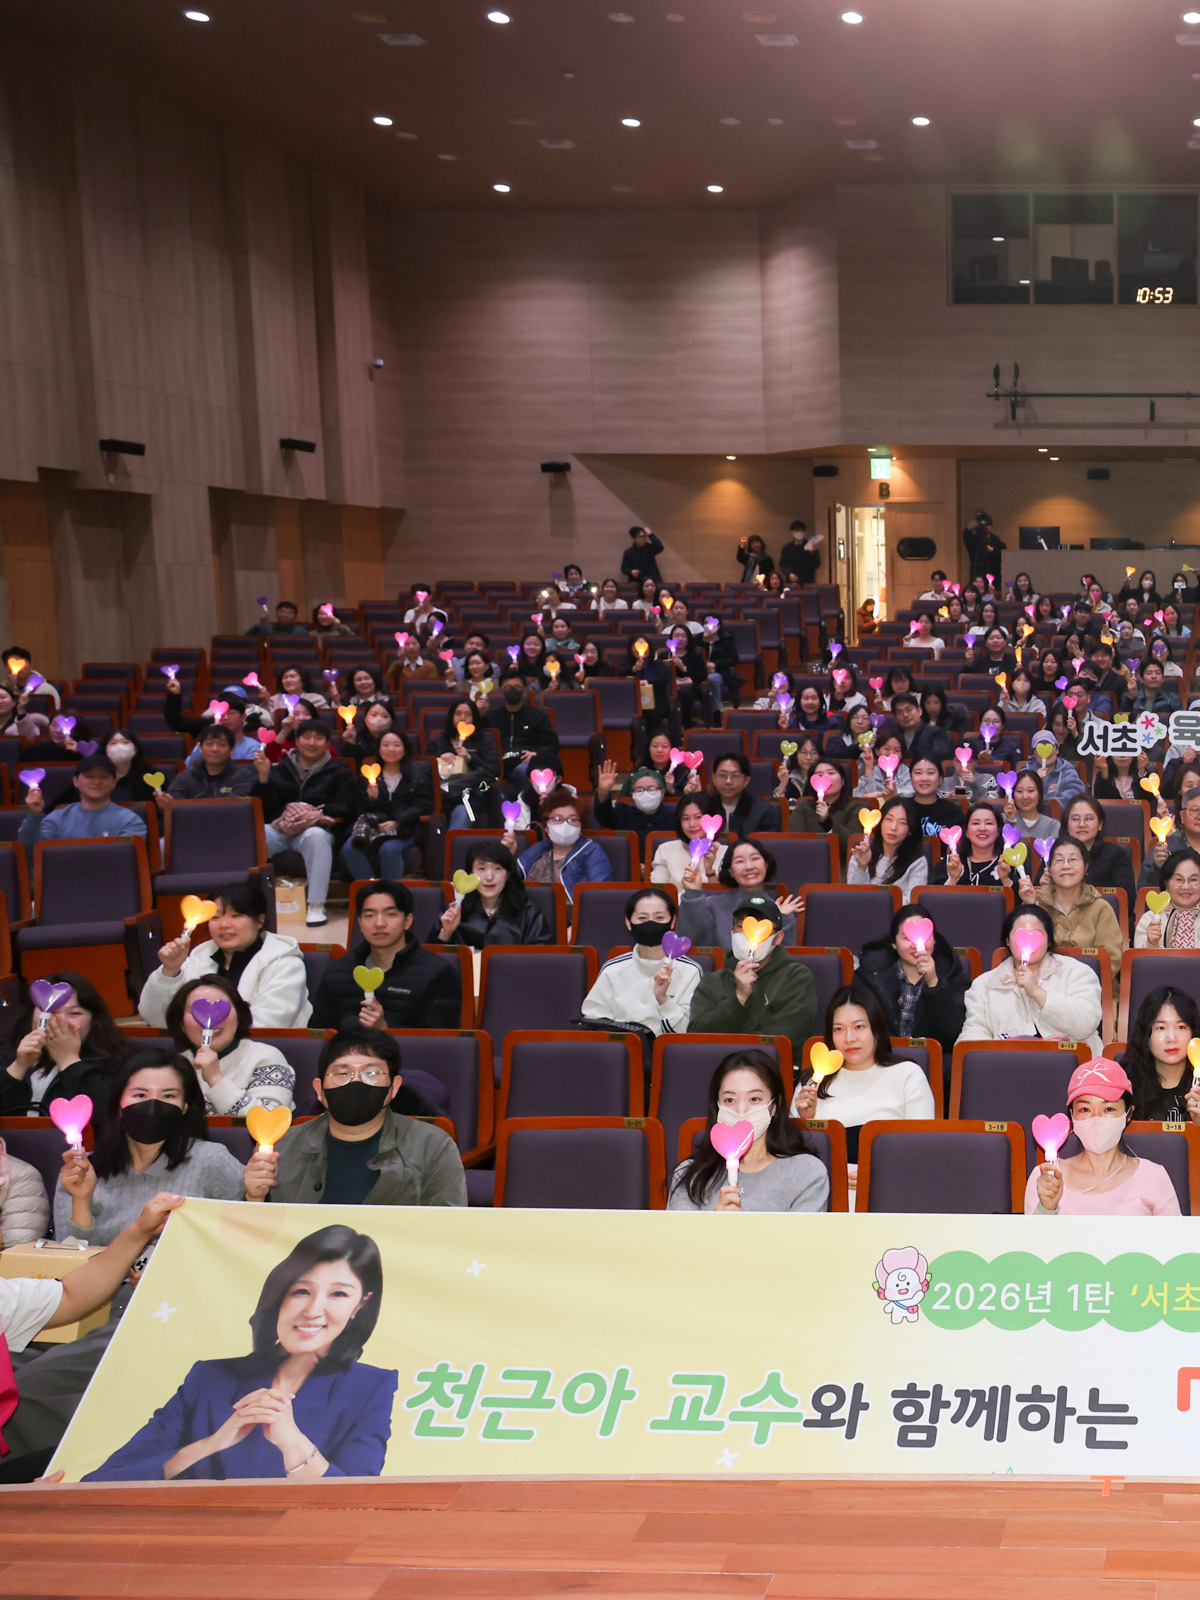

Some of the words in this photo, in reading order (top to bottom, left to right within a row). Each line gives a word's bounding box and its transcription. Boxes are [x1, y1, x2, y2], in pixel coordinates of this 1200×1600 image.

[1136, 287, 1174, 304] 10:53
[878, 482, 891, 499] B
[1081, 723, 1139, 753] 서초
[988, 1123, 1004, 1131] 3-19
[1166, 1123, 1182, 1131] 3-18
[931, 1281, 1052, 1313] 2026년
[1066, 1281, 1115, 1314] 1탄
[405, 1362, 637, 1440] 천근아
[648, 1371, 870, 1446] 교수와
[890, 1382, 1139, 1450] 함께하는
